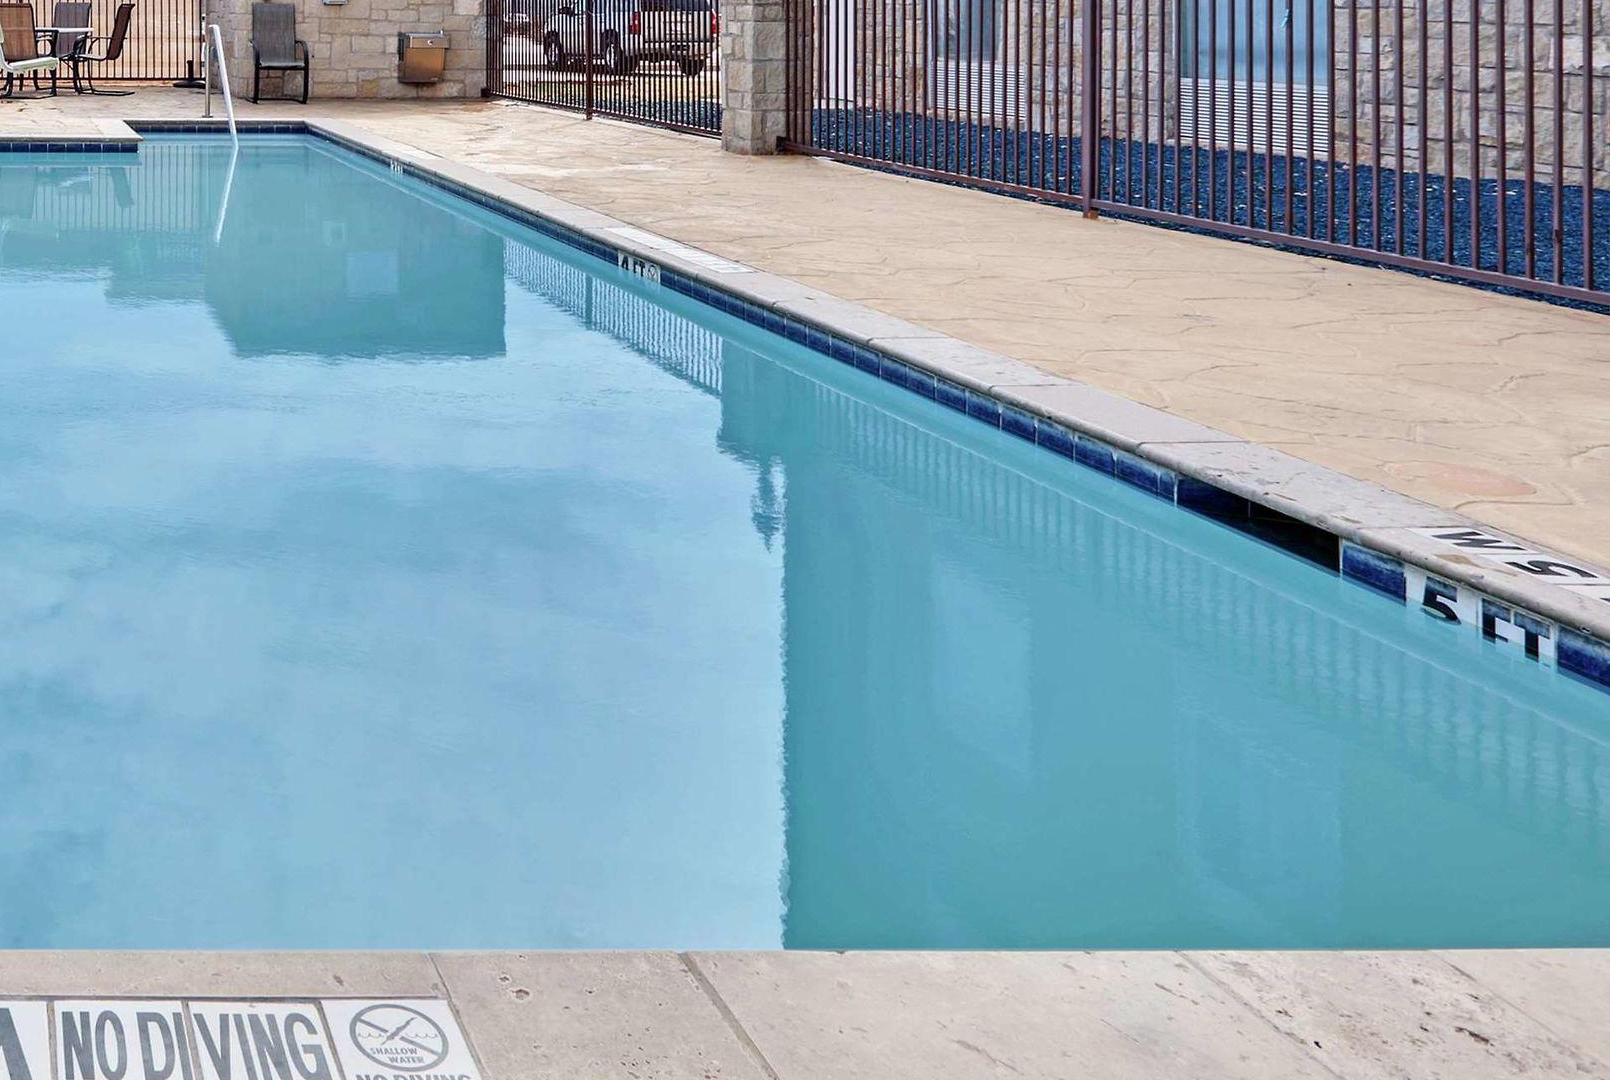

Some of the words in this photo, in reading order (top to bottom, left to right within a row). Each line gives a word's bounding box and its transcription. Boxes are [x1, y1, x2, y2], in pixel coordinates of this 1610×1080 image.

[1421, 575, 1462, 626] 5
[1481, 597, 1551, 663] FT
[61, 1009, 128, 1080] NO
[136, 1011, 333, 1080] DIVING
[370, 1047, 418, 1056] SHALLOW
[388, 1056, 424, 1064] WATER
